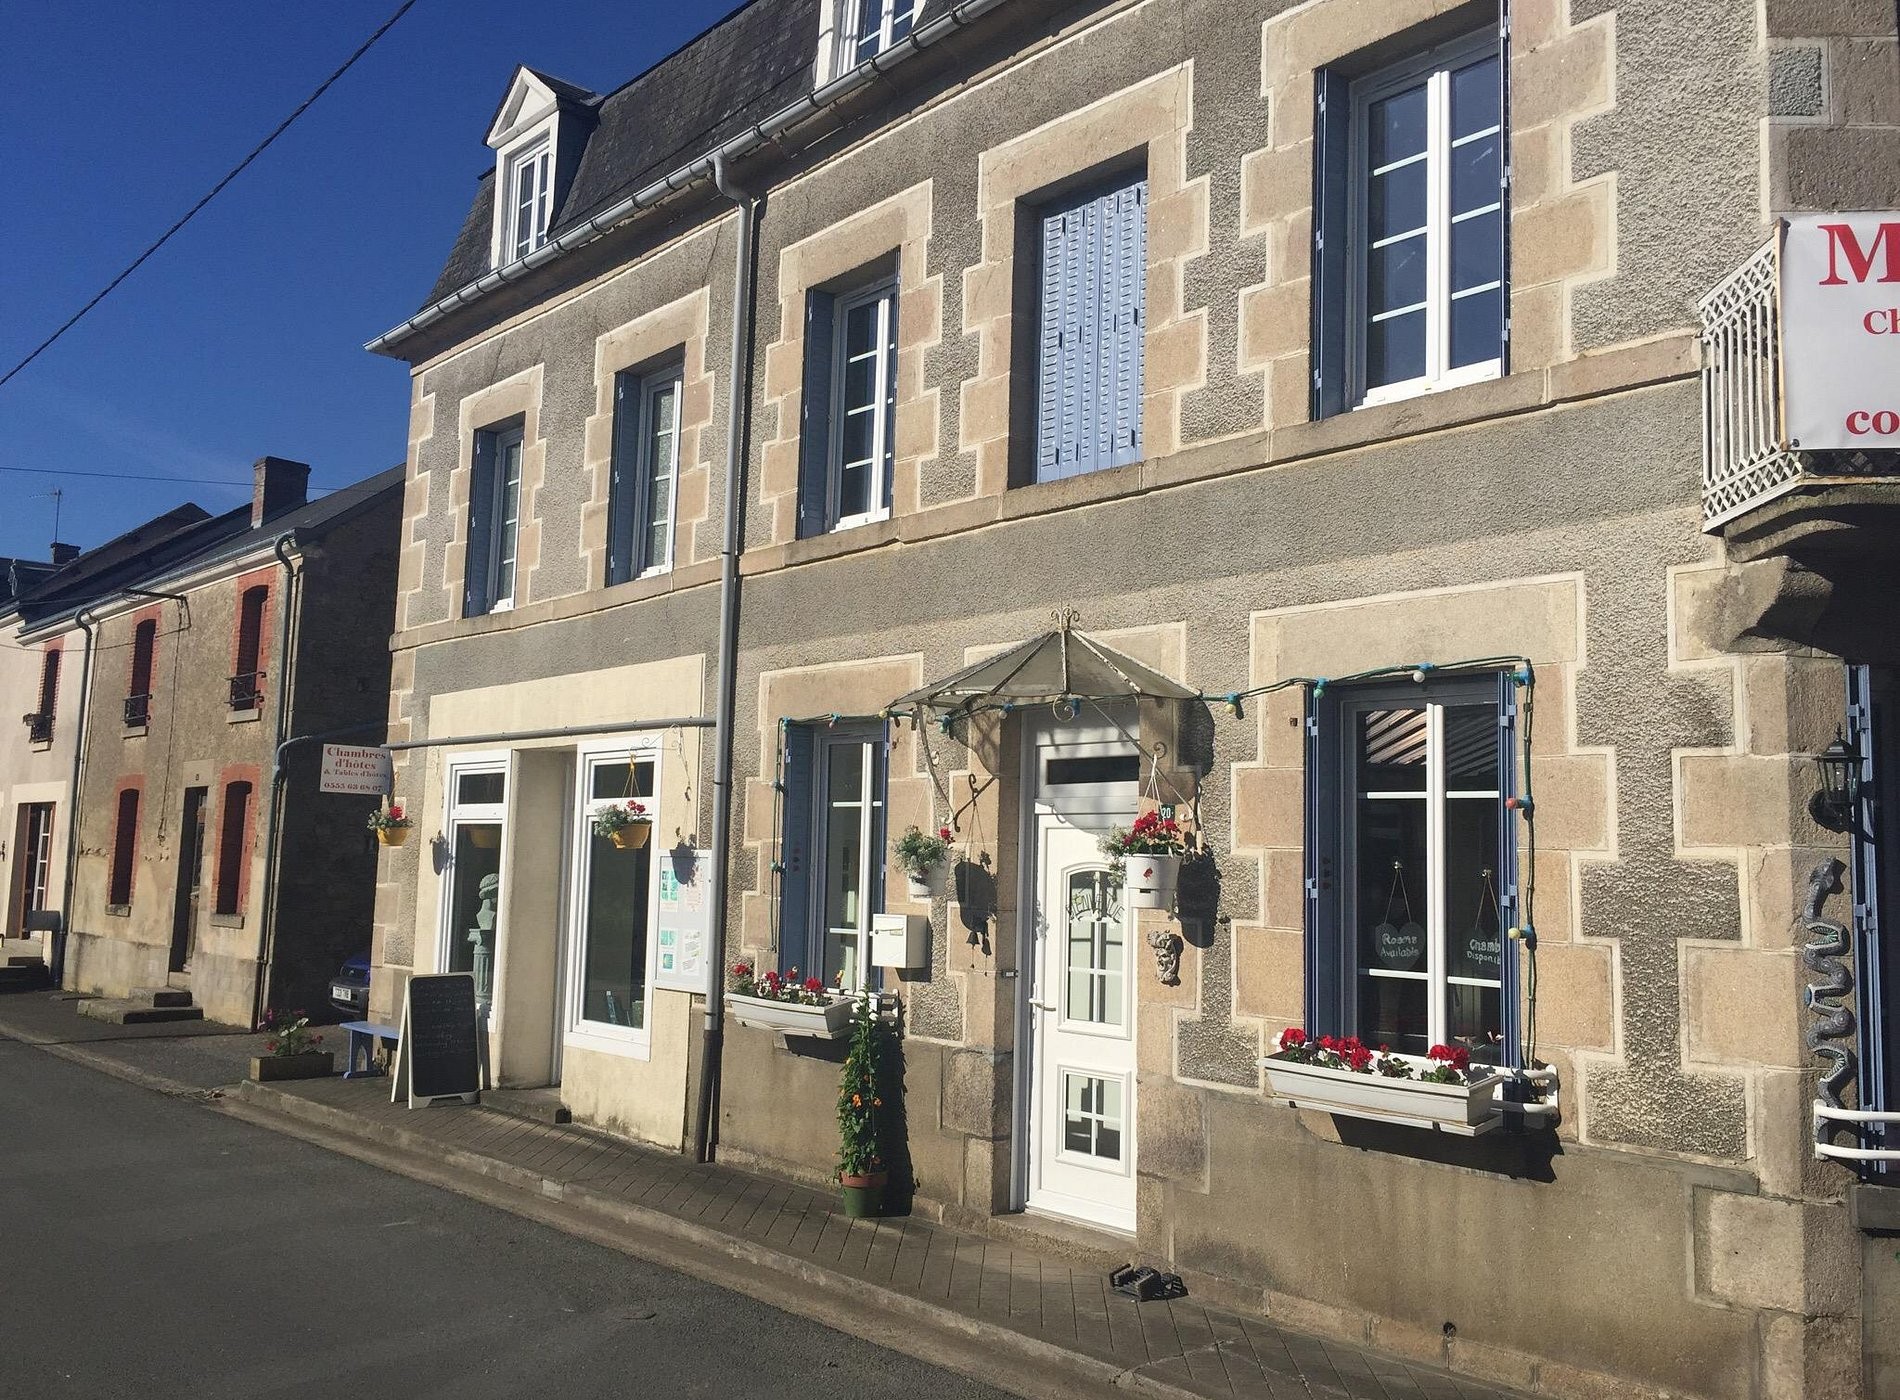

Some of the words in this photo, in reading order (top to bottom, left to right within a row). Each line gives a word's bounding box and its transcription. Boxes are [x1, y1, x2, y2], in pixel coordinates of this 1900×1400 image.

[1817, 223, 1900, 285] M
[1846, 410, 1900, 435] co
[326, 746, 386, 760] Chambres
[335, 758, 377, 770] d'hôtes
